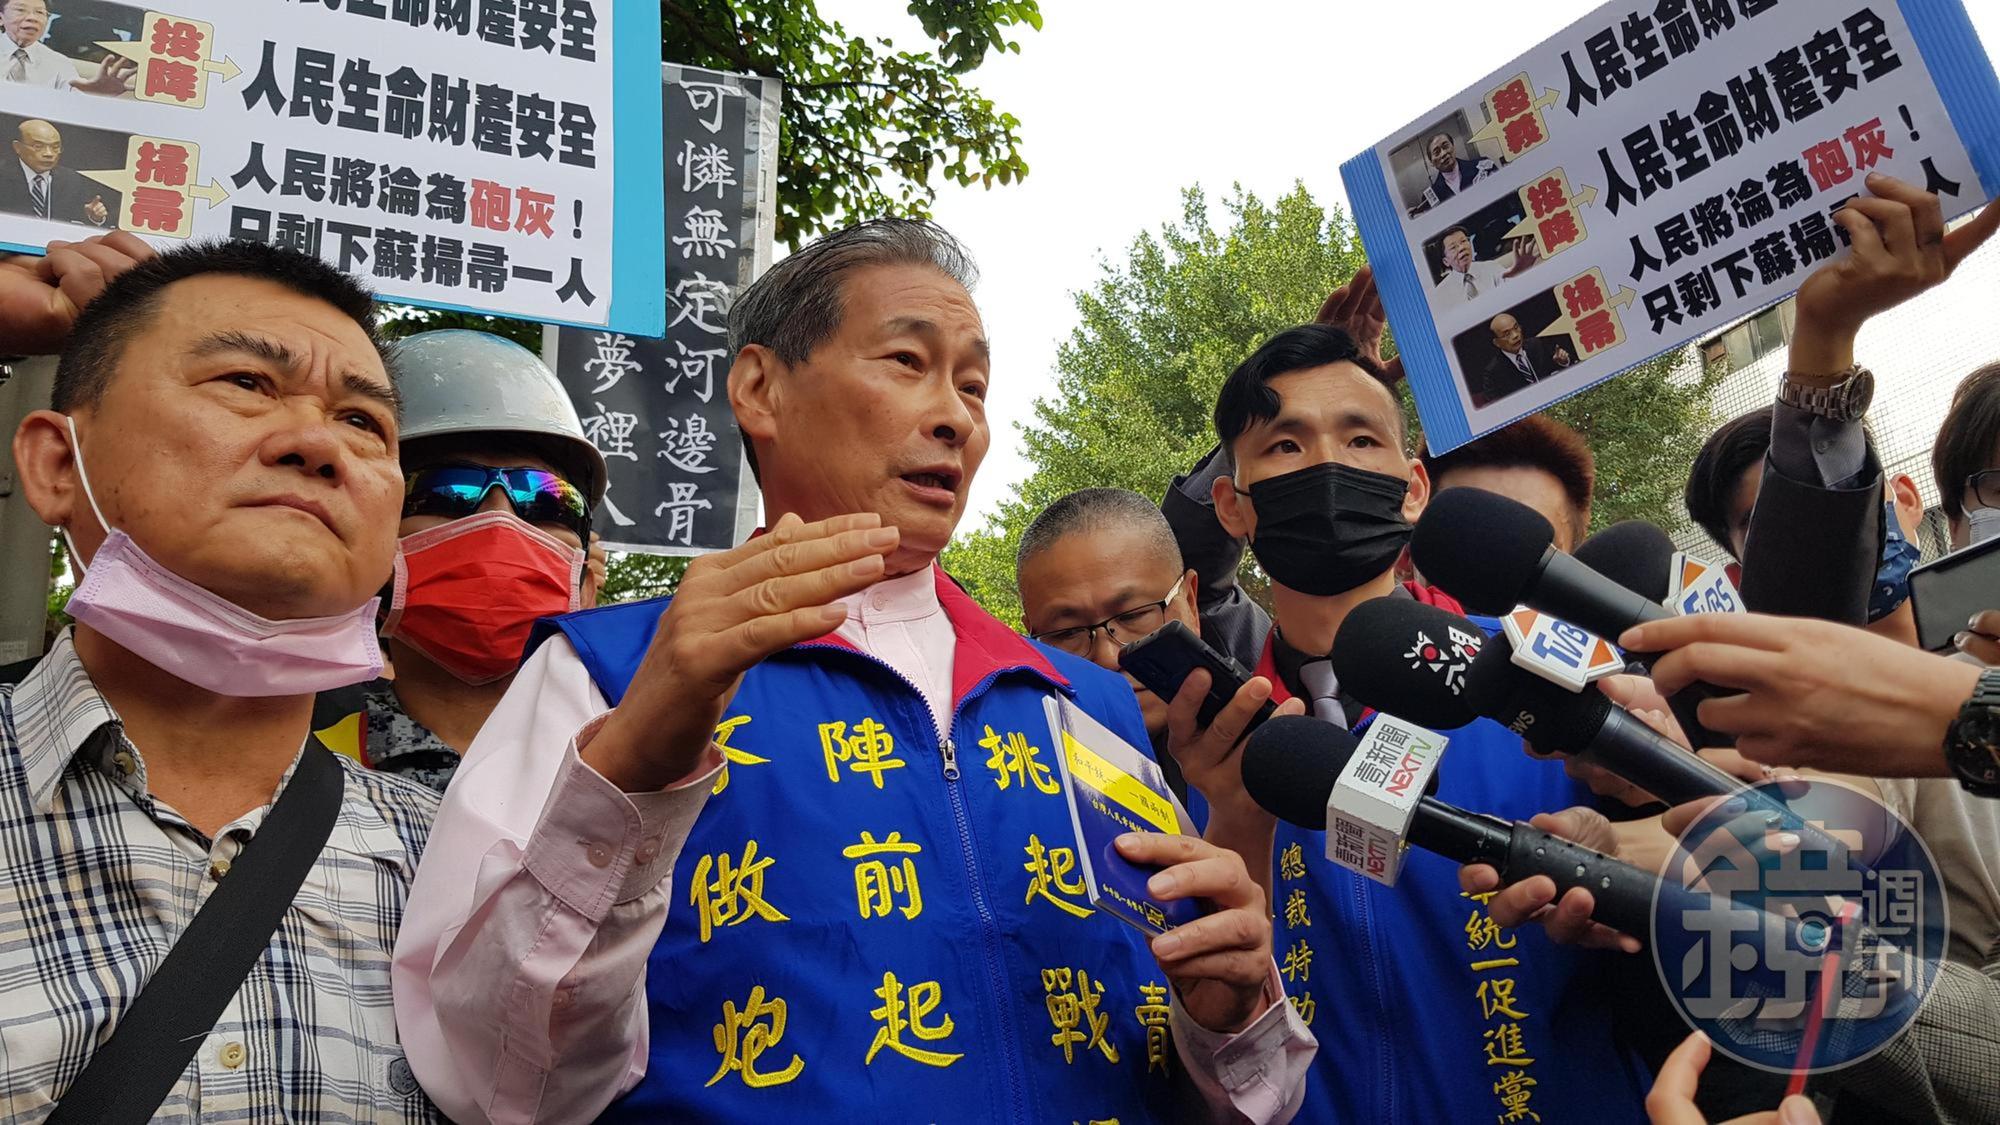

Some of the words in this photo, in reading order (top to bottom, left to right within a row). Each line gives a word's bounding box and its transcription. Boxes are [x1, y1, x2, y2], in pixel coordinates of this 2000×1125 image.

[145, 18, 204, 102] 投降
[241, 40, 596, 169] 人民生命財產安全
[1561, 0, 1778, 117] 人民生命財
[1598, 7, 1902, 217] 人民生命財產安全
[1527, 177, 1579, 254] 投降
[656, 80, 743, 546] 可憐無定河邊骨
[1531, 620, 1589, 669] TVB
[1683, 577, 1735, 614] TBS
[1354, 723, 1412, 788] 壹新聞
[978, 724, 1120, 1125] 挑起戰
